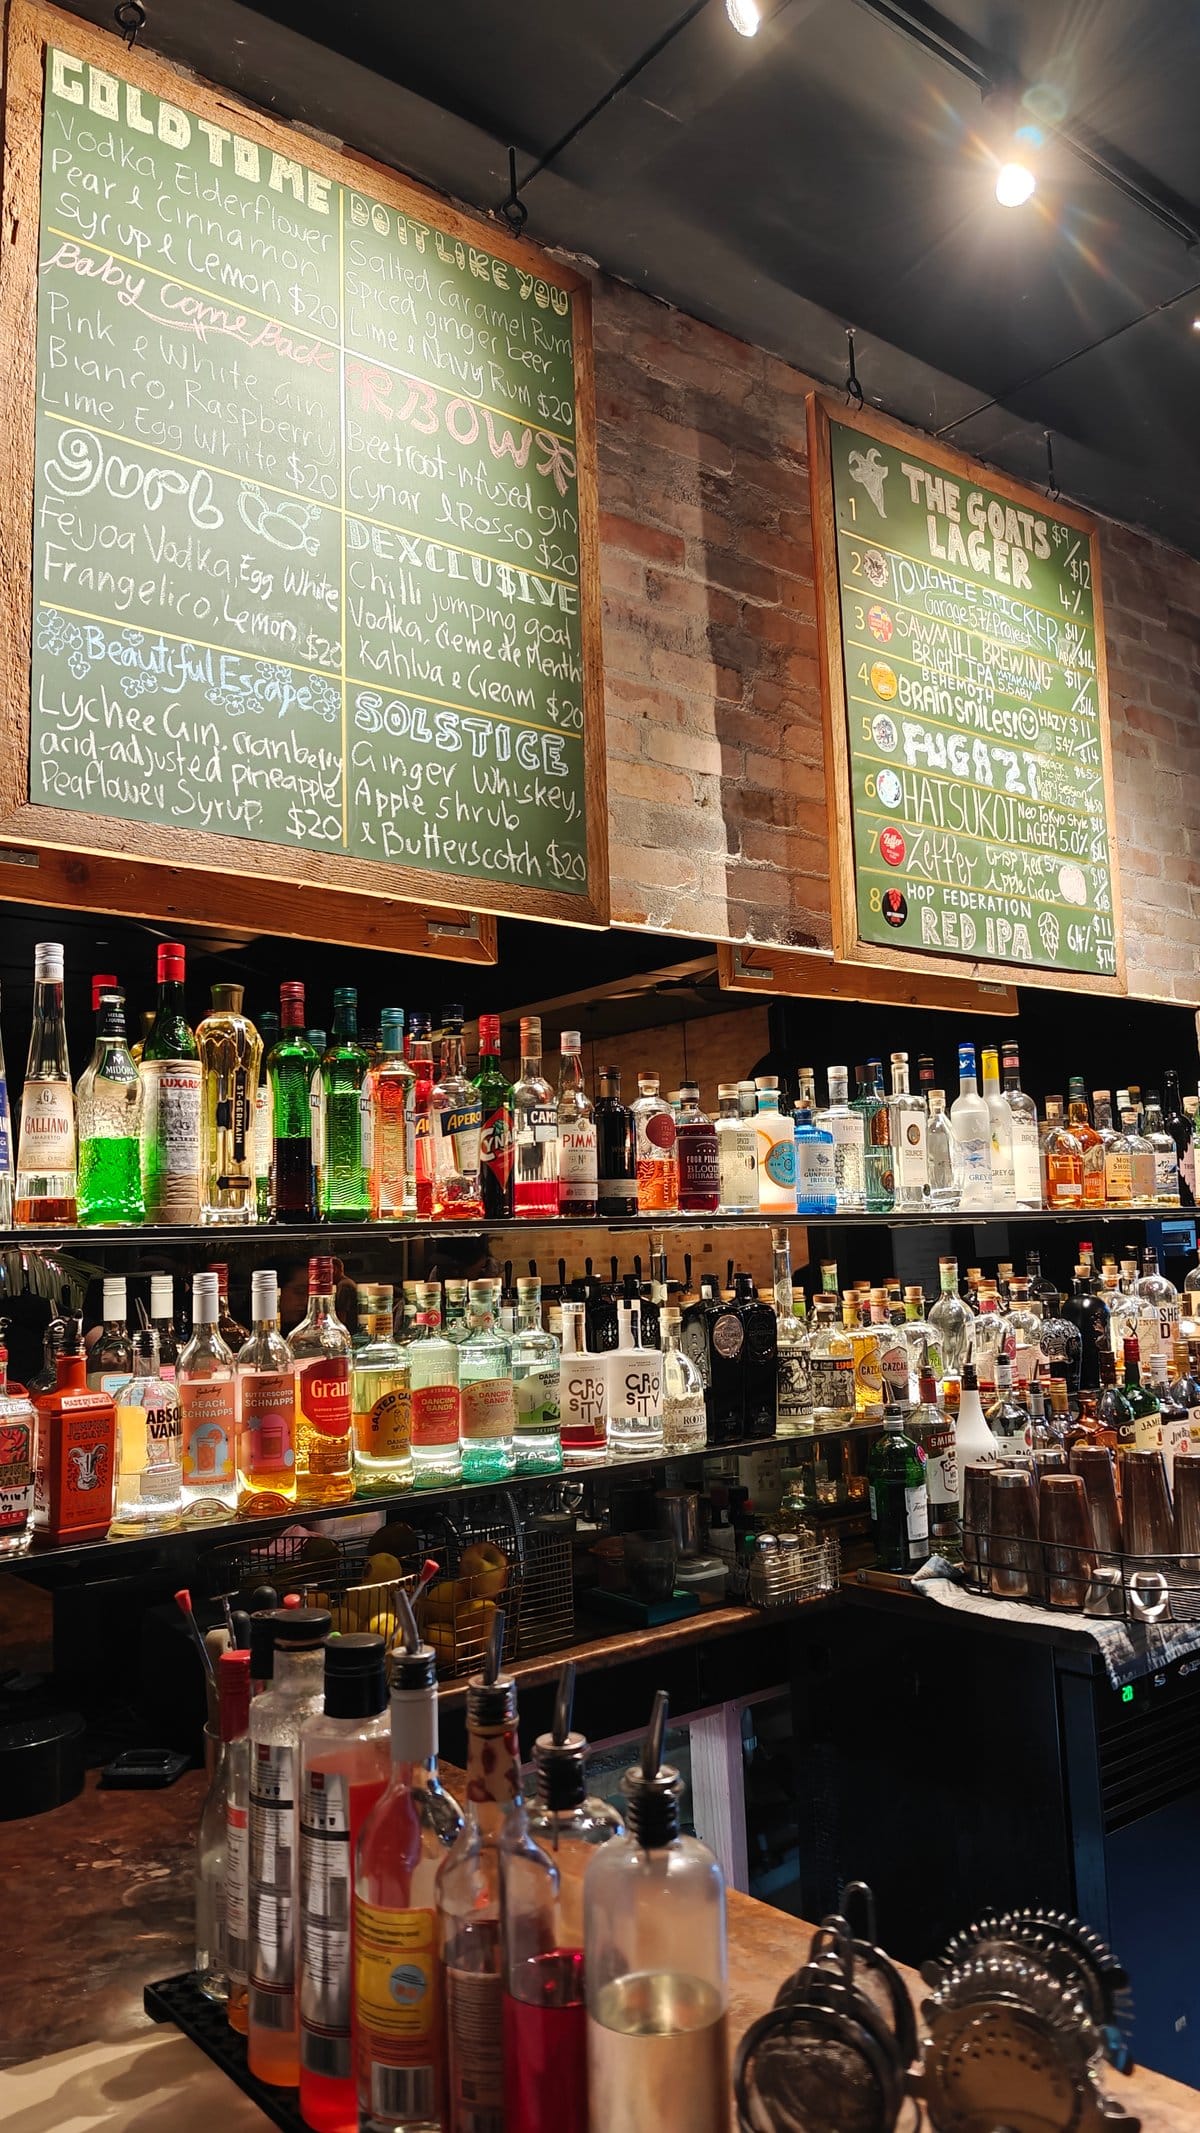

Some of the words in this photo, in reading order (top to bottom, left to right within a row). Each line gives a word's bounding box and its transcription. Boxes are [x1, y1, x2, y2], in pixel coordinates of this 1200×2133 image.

[52, 48, 191, 150] COLD
[198, 119, 260, 183] TO
[268, 152, 332, 215] ME
[52, 148, 117, 200] Pear
[157, 195, 320, 283] Cinnamon
[174, 162, 333, 254] Elderflower
[55, 192, 151, 259] Syrup
[187, 238, 281, 304] Lemon
[288, 283, 338, 330] $20
[350, 192, 390, 237] DO
[396, 214, 430, 254] IT
[435, 231, 511, 291] LIKE
[514, 267, 568, 316] YOU
[40, 241, 146, 306] Baby
[160, 282, 250, 336] Come
[249, 321, 336, 373] Back
[345, 271, 418, 325] Spiced
[424, 310, 498, 355] ginger
[349, 238, 432, 301] Salted
[438, 279, 527, 342] Caramel
[47, 291, 116, 348] Pink
[159, 335, 258, 401] White
[349, 308, 399, 350] Lime
[422, 336, 485, 399] Navy
[487, 359, 532, 407] Rum
[537, 390, 573, 426] $20
[134, 406, 183, 451] Egg
[194, 424, 278, 476] White
[286, 450, 338, 501] $20
[349, 465, 421, 514] Cynar
[458, 500, 533, 551] Rosso
[534, 537, 578, 577] $20
[537, 504, 577, 536] gin
[901, 462, 962, 525] THE
[966, 491, 1052, 562] GOATS
[848, 497, 857, 521] 1
[925, 514, 1033, 592] LAGER
[239, 553, 275, 601] Egg
[284, 567, 340, 613] White
[349, 560, 422, 606] Chilli
[850, 551, 863, 576] 2
[981, 587, 1060, 659] STICKER
[923, 590, 969, 627] Garage
[223, 594, 298, 642] Lemon
[299, 627, 343, 669] $20
[497, 632, 521, 669] de
[854, 605, 866, 631] 3
[894, 611, 979, 662] SAWMILL
[981, 633, 1054, 691] BREWING
[82, 624, 214, 695] Beautiful
[219, 654, 315, 720] Escape
[359, 635, 446, 687] Kahlua
[467, 664, 536, 710] Cream
[546, 689, 584, 729] $20
[857, 665, 870, 686] 4
[921, 668, 995, 705] BEHEMOTH
[912, 639, 963, 680] BRIGHT
[965, 658, 996, 690] IPA
[38, 674, 158, 738] Lychee
[861, 716, 872, 741] 5
[1038, 708, 1068, 734] HAZY
[354, 691, 570, 778] SOLSTICE
[351, 739, 458, 792] Ginger
[864, 773, 876, 798] 6
[40, 759, 165, 810] Peaflower
[286, 803, 343, 841] $20
[354, 777, 427, 818] Apple
[381, 821, 543, 878] Butterscotch
[546, 838, 587, 882] $20
[867, 829, 879, 855] 7
[902, 823, 978, 887] Zeffer
[1017, 821, 1058, 850] LAGER
[868, 887, 882, 913] 8
[906, 882, 935, 902] HOP
[943, 888, 1033, 920] FEDERATION
[984, 868, 1027, 895] Apple
[920, 906, 977, 951] RED
[985, 916, 1034, 960] IPA
[160, 1078, 201, 1088] LUXARD
[24, 1115, 69, 1135] GALLIANO
[235, 1085, 244, 1144] ST-GERMAIN
[182, 1407, 234, 1418] SCHNAPPS
[191, 1399, 226, 1408] PEACH
[244, 1389, 294, 1398] BUTTERSCOTCH
[244, 1397, 294, 1408] SCHNAPPS
[371, 1395, 396, 1432] SALTED
[421, 1396, 456, 1405] DANCING
[426, 1404, 453, 1412] SANDS
[478, 1390, 511, 1399] DANCING
[484, 1396, 509, 1405] SANDS
